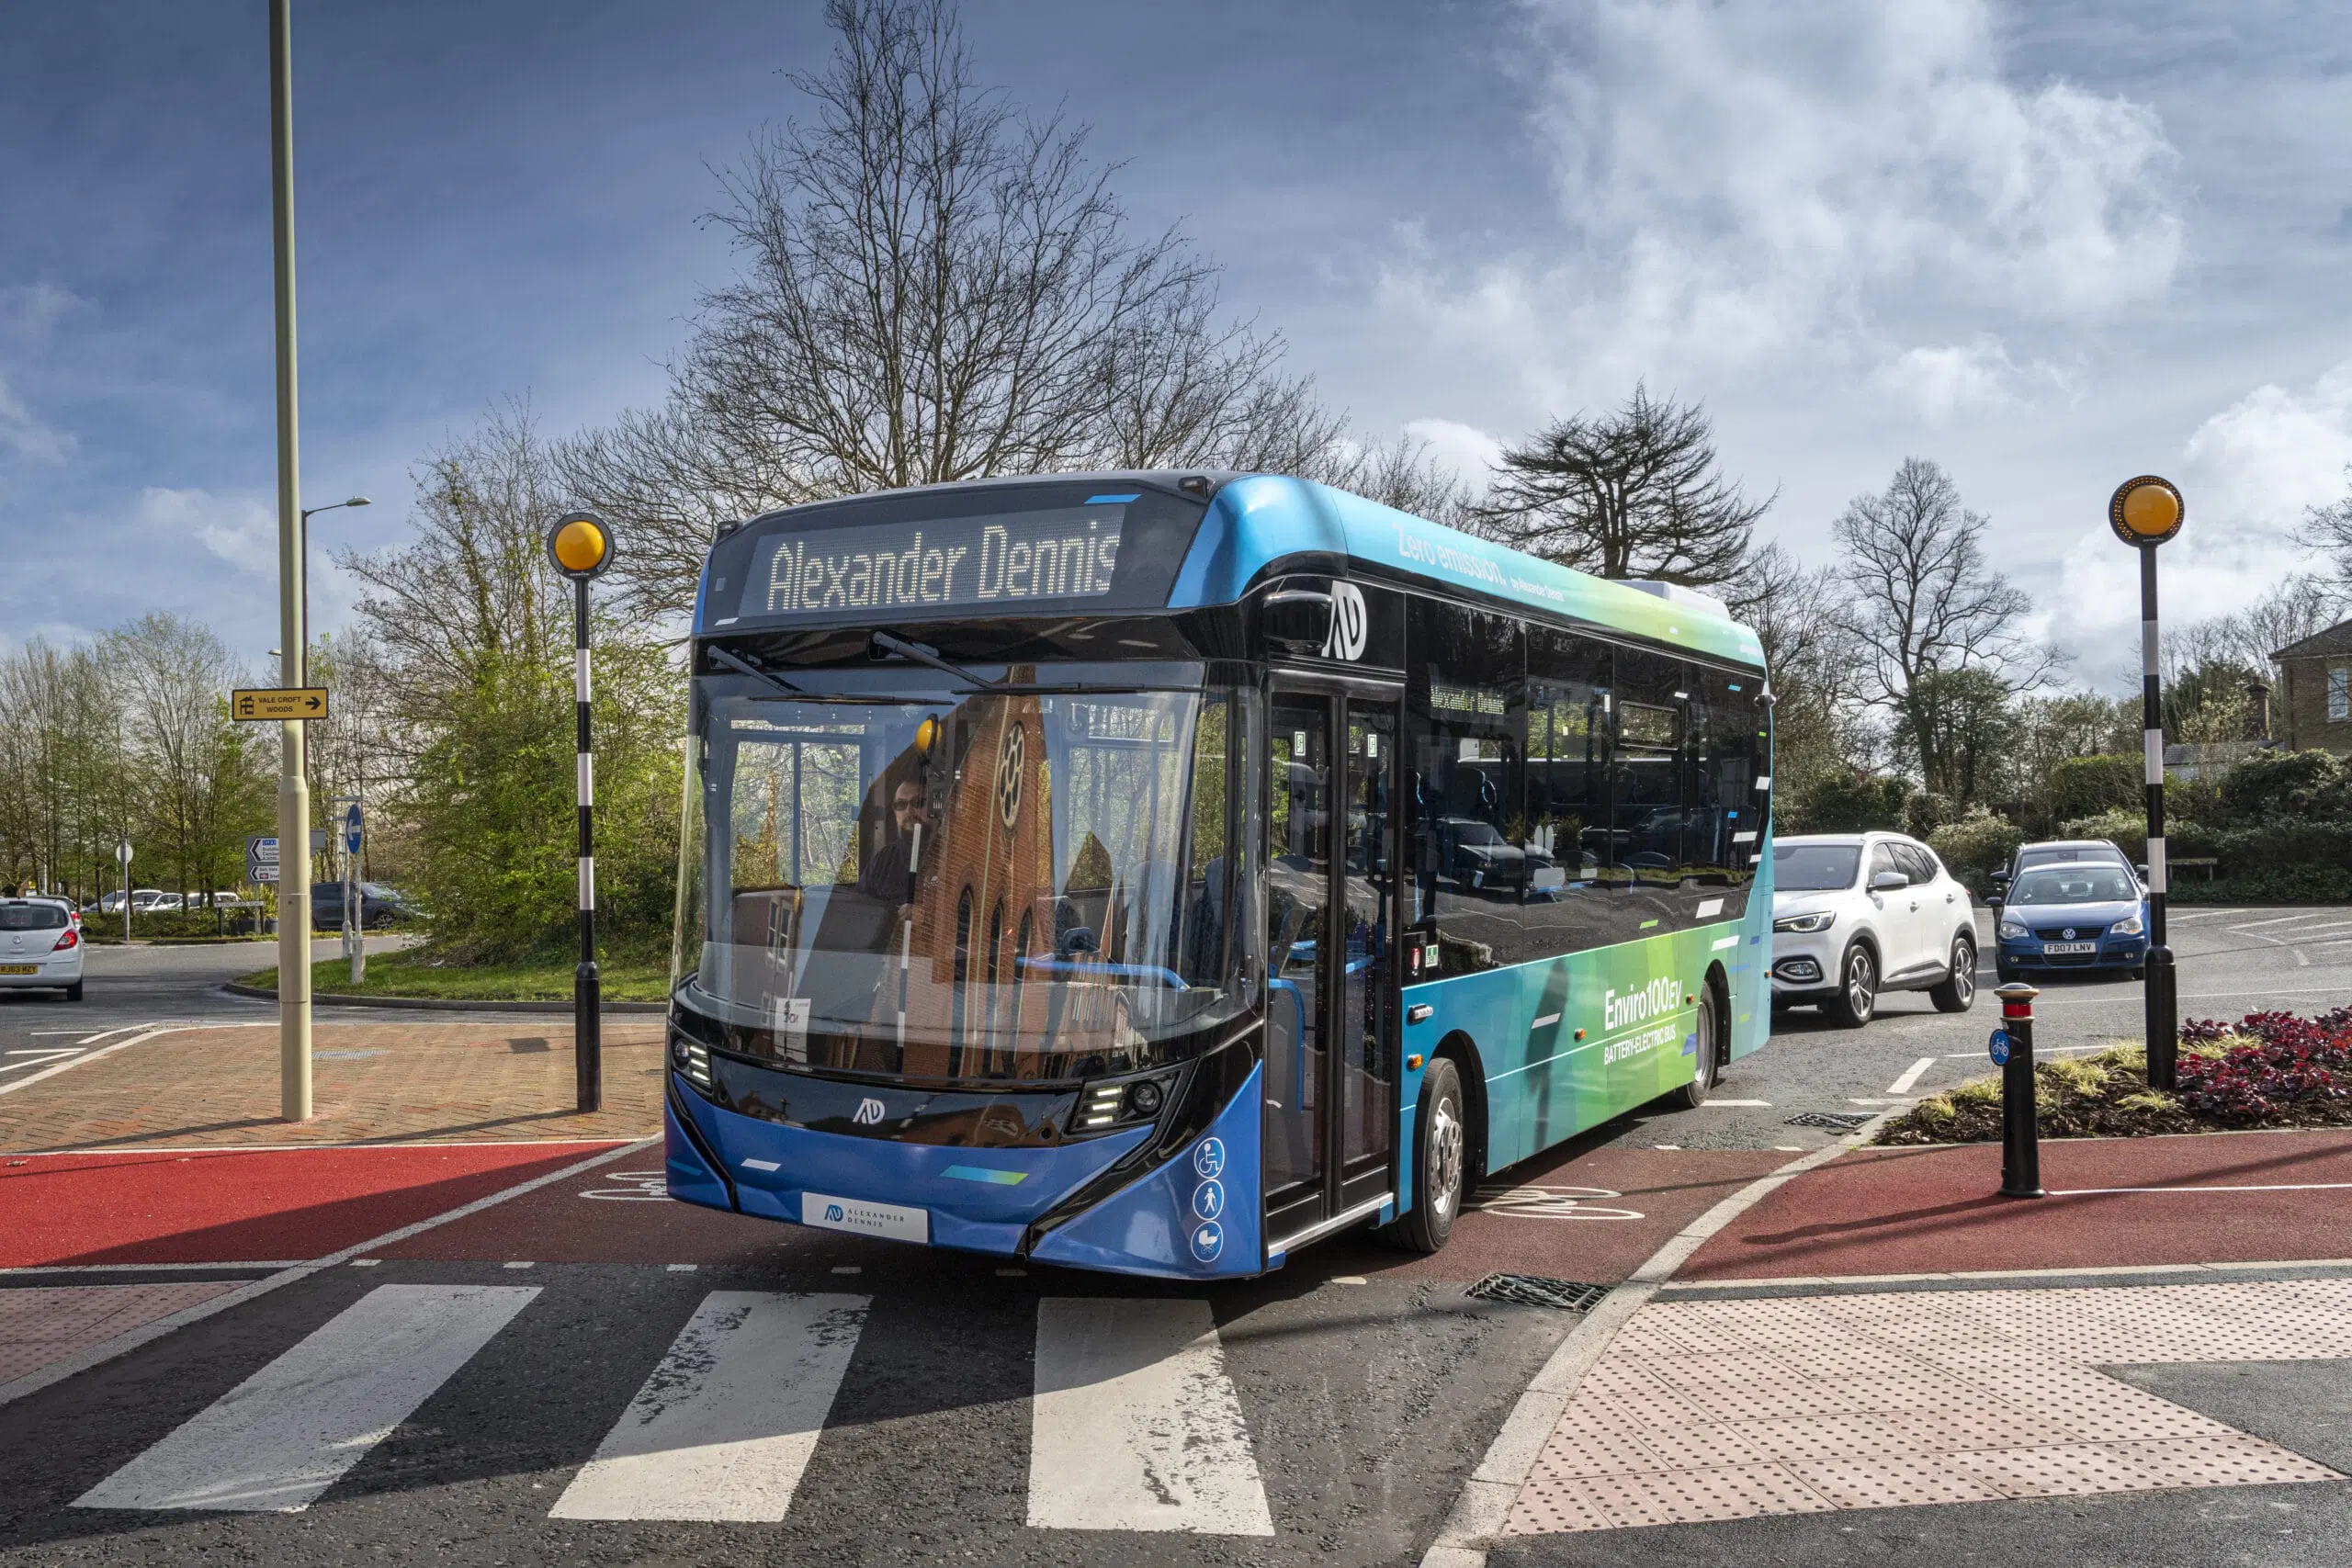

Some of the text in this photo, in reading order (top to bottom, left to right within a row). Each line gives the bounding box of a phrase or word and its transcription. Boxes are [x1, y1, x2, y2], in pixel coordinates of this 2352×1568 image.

[767, 522, 1120, 610] Alexander Dennis
[1391, 522, 1436, 565] Zero
[1436, 544, 1507, 587] emission.
[2048, 943, 2091, 953] FD07 LNV
[1605, 976, 1682, 1031] Enviro100EV
[1604, 1023, 1677, 1066] BATTERY-ELECTRIC BUS
[847, 1208, 905, 1222] ALEXANDER
[847, 1217, 883, 1227] DENNIS
